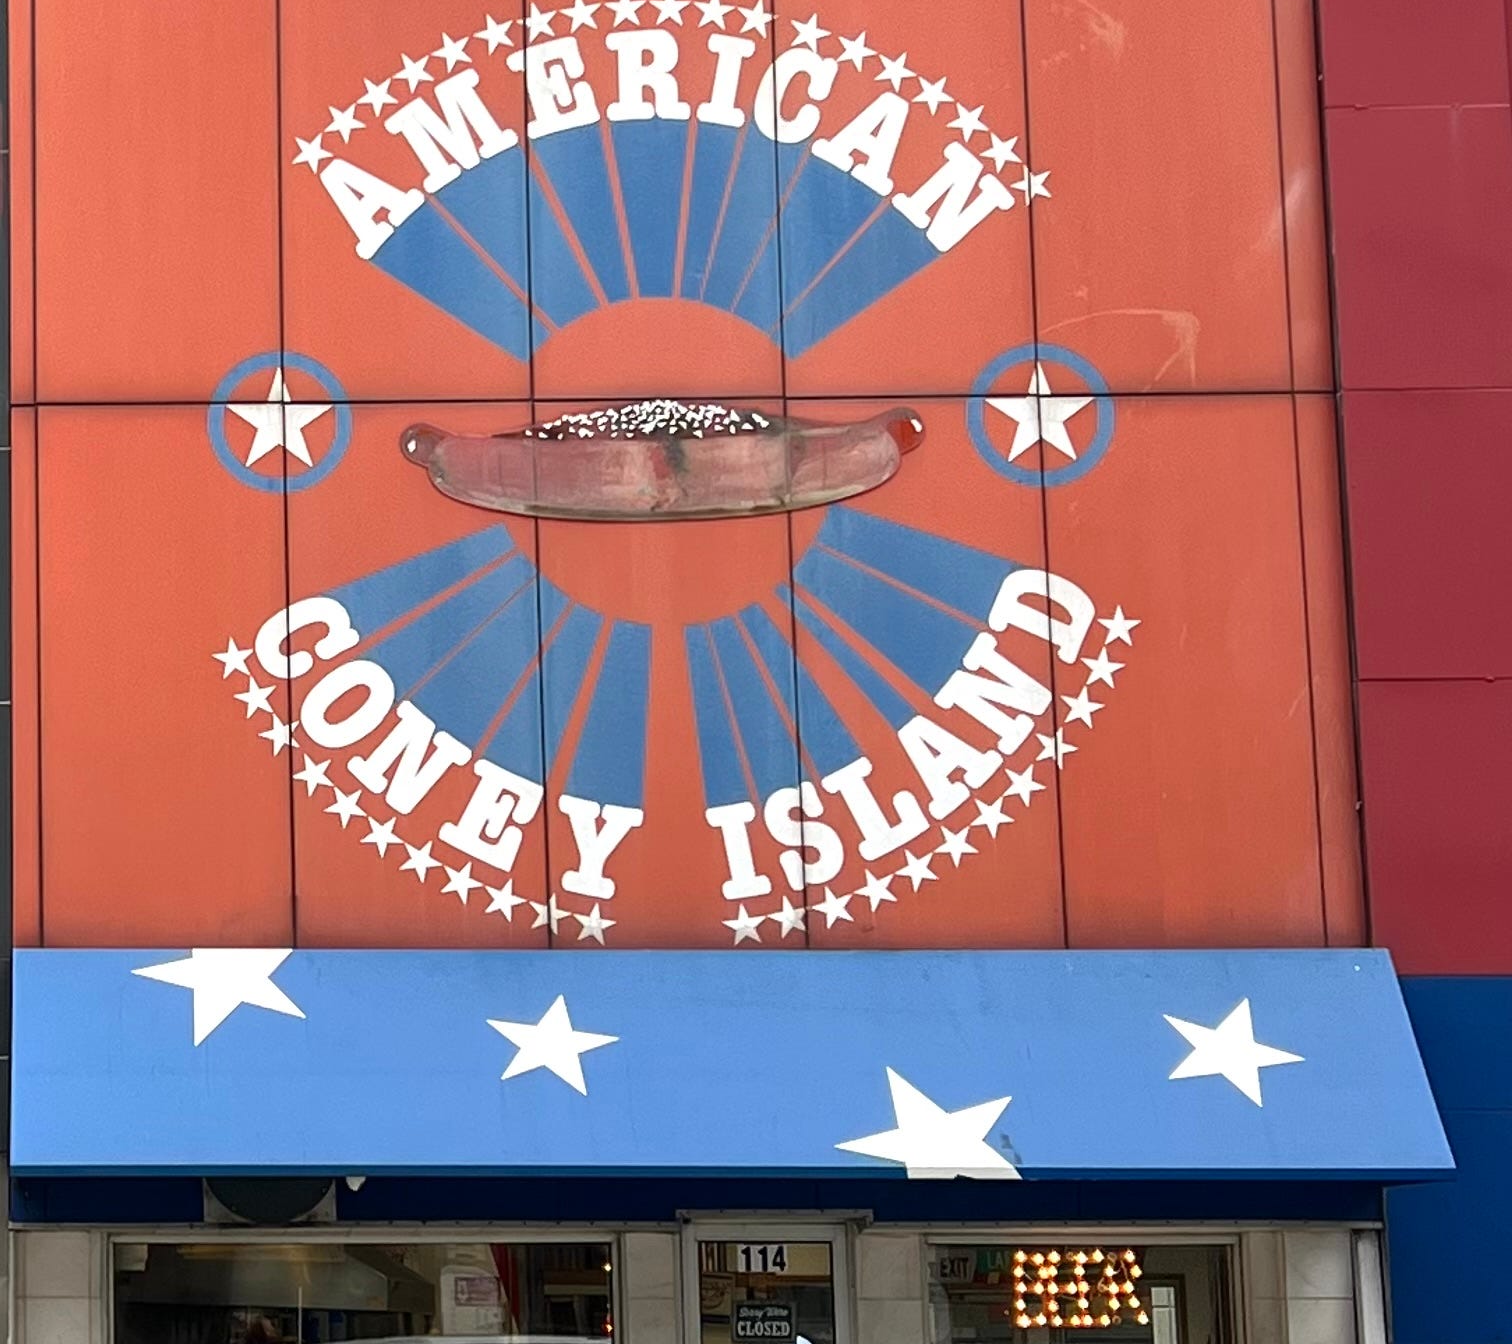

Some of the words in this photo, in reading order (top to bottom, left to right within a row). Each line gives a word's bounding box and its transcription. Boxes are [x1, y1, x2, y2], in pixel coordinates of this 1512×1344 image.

[318, 28, 1016, 260] AMERICAN
[254, 595, 643, 902] CONEY
[706, 567, 1100, 902] ISLAND
[741, 1245, 786, 1272] 114
[940, 1257, 969, 1280] EXIT
[737, 1321, 791, 1337] CLOSED
